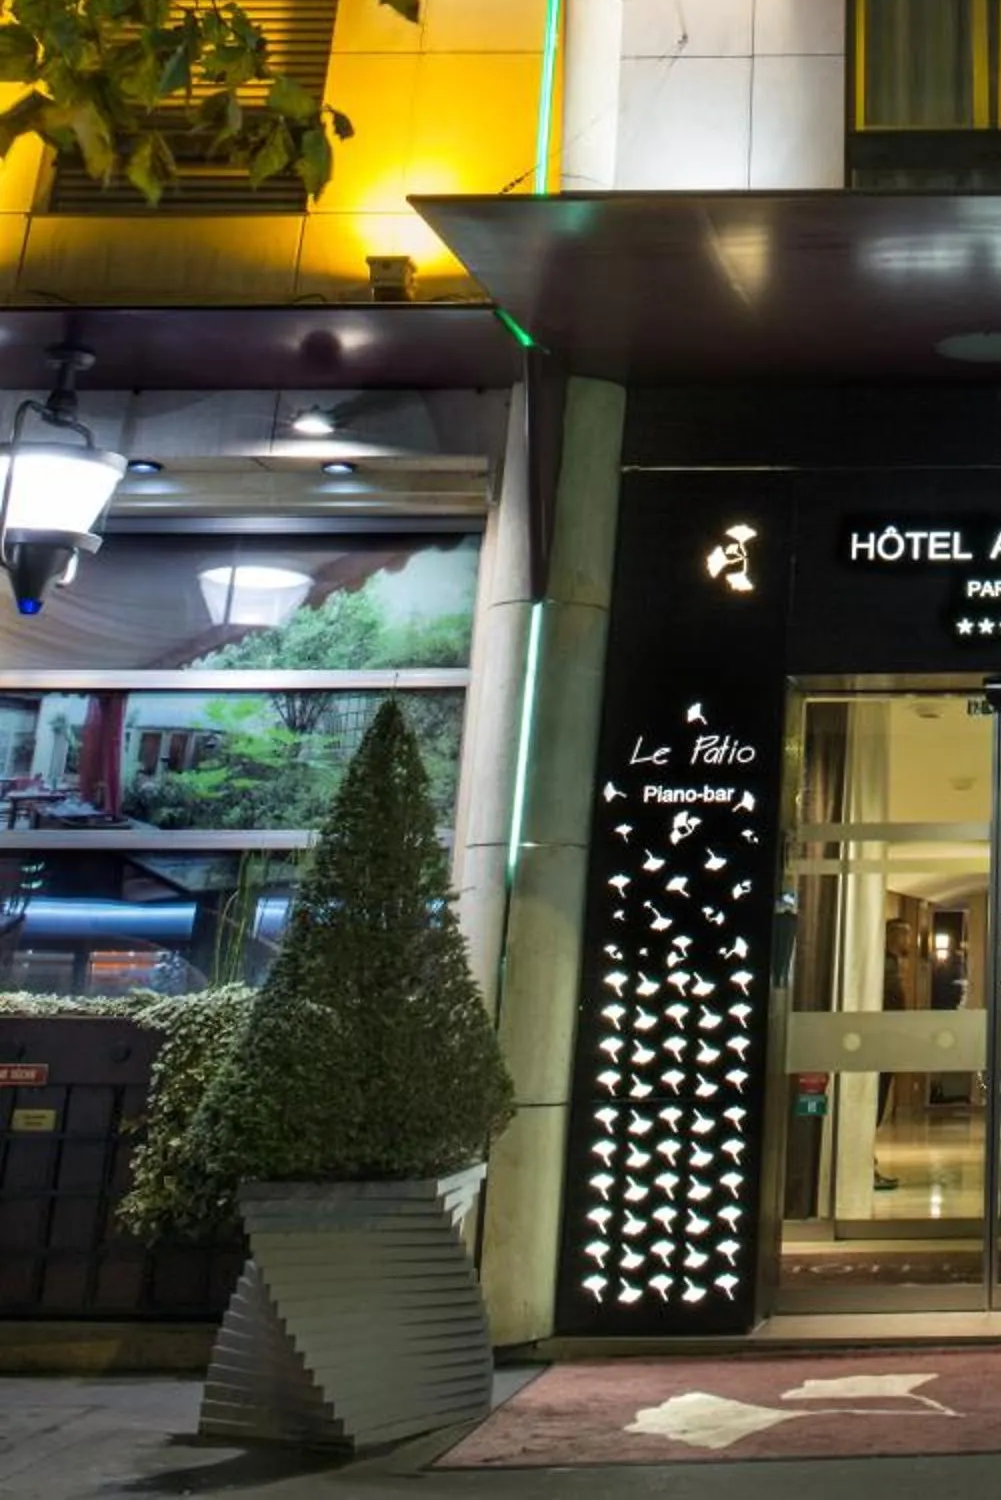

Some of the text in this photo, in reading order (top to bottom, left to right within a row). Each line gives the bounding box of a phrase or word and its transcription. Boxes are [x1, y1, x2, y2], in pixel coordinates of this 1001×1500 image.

[851, 525, 974, 561] HÔTEL
[629, 734, 756, 765] Le Patio
[643, 784, 736, 803] Piano-bar
